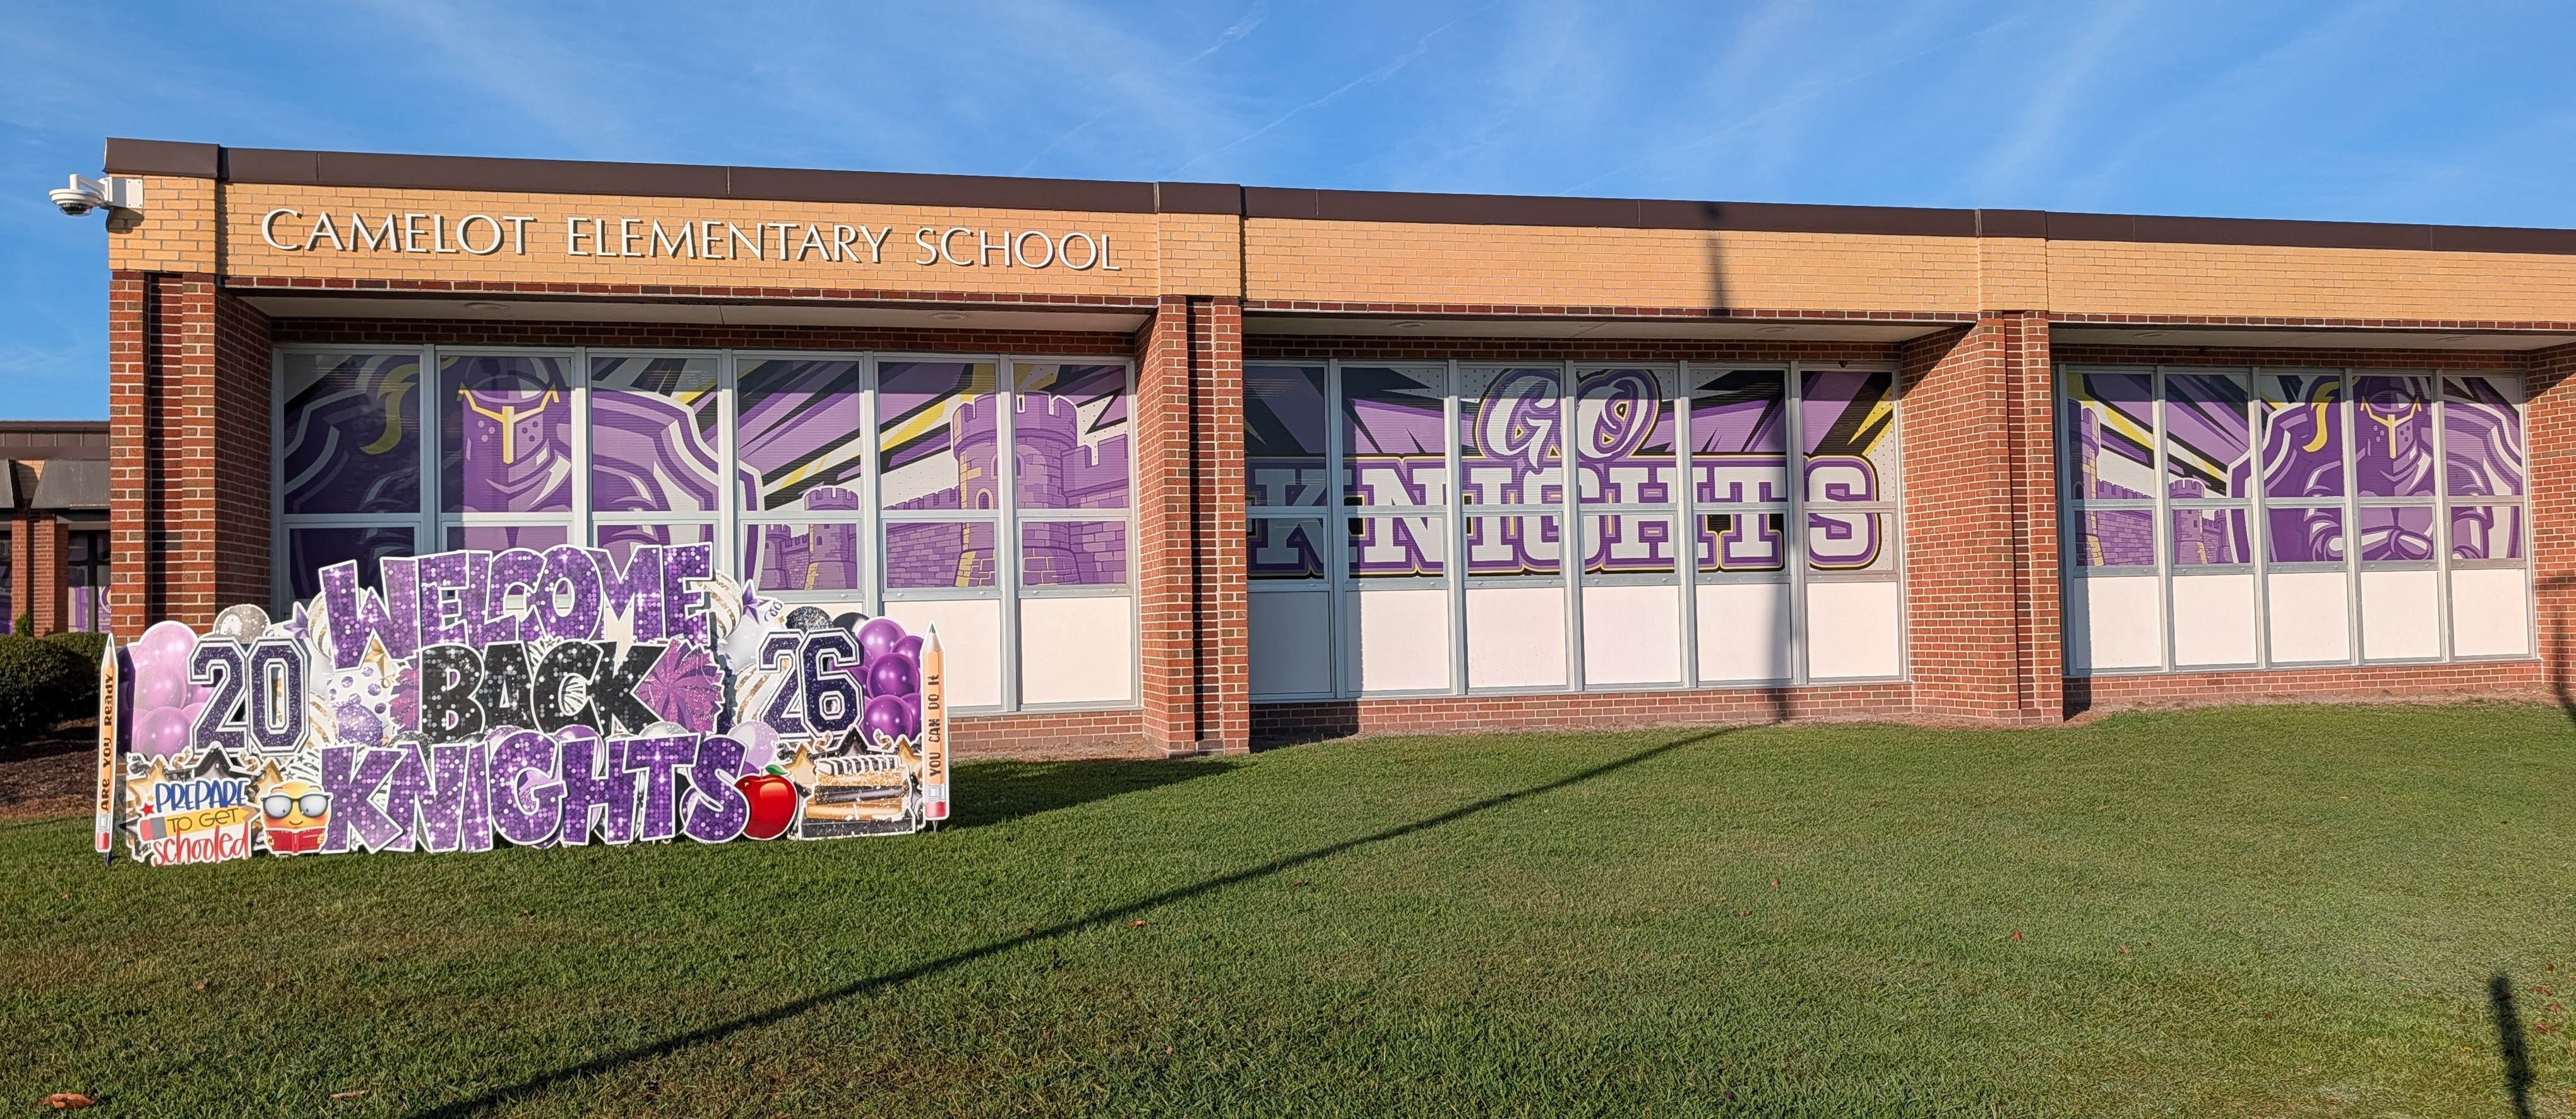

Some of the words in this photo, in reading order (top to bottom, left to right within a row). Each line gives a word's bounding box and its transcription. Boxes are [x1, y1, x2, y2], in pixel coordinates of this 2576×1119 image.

[261, 208, 537, 256] CAMELOT
[567, 216, 891, 264] ELEMENTARY
[914, 227, 1121, 271] SCHOOL
[1477, 370, 1657, 468] GO
[1253, 466, 1880, 567] KNIGHTS
[318, 543, 713, 671] WELCOME
[188, 636, 311, 754] 20
[418, 641, 669, 743] BACK
[758, 627, 866, 743] 26
[927, 694, 940, 710] DO
[102, 737, 112, 768] YOU
[928, 719, 941, 743] CAN
[320, 732, 750, 854] KNIGHTS
[929, 752, 942, 777] YOU
[155, 780, 248, 813] PREPARE
[167, 816, 193, 832] TO
[153, 822, 249, 865] schooled
